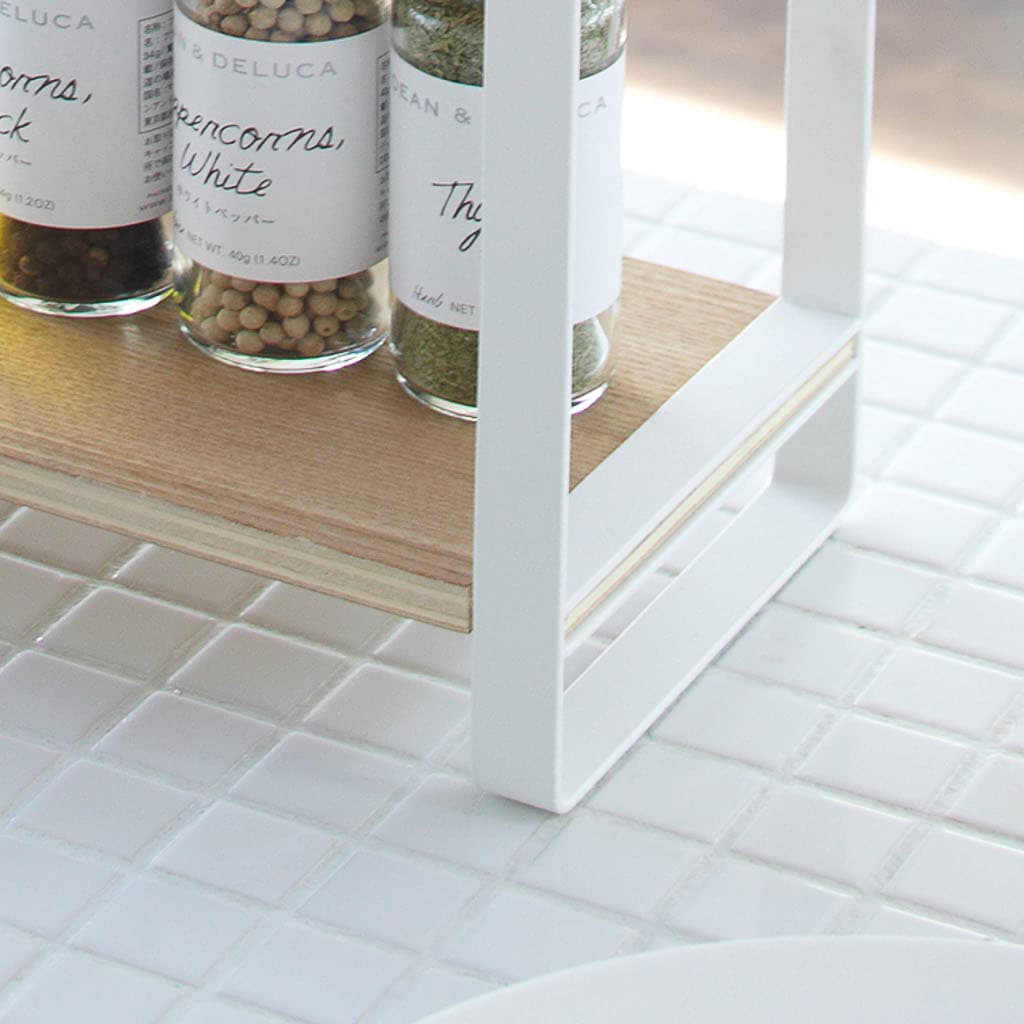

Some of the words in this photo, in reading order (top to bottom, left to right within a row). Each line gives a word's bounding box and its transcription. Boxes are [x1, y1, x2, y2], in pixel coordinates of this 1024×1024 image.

[212, 52, 338, 78] DELUCA
[454, 107, 471, 125] &
[180, 142, 273, 197] White
[450, 301, 476, 317] NET
